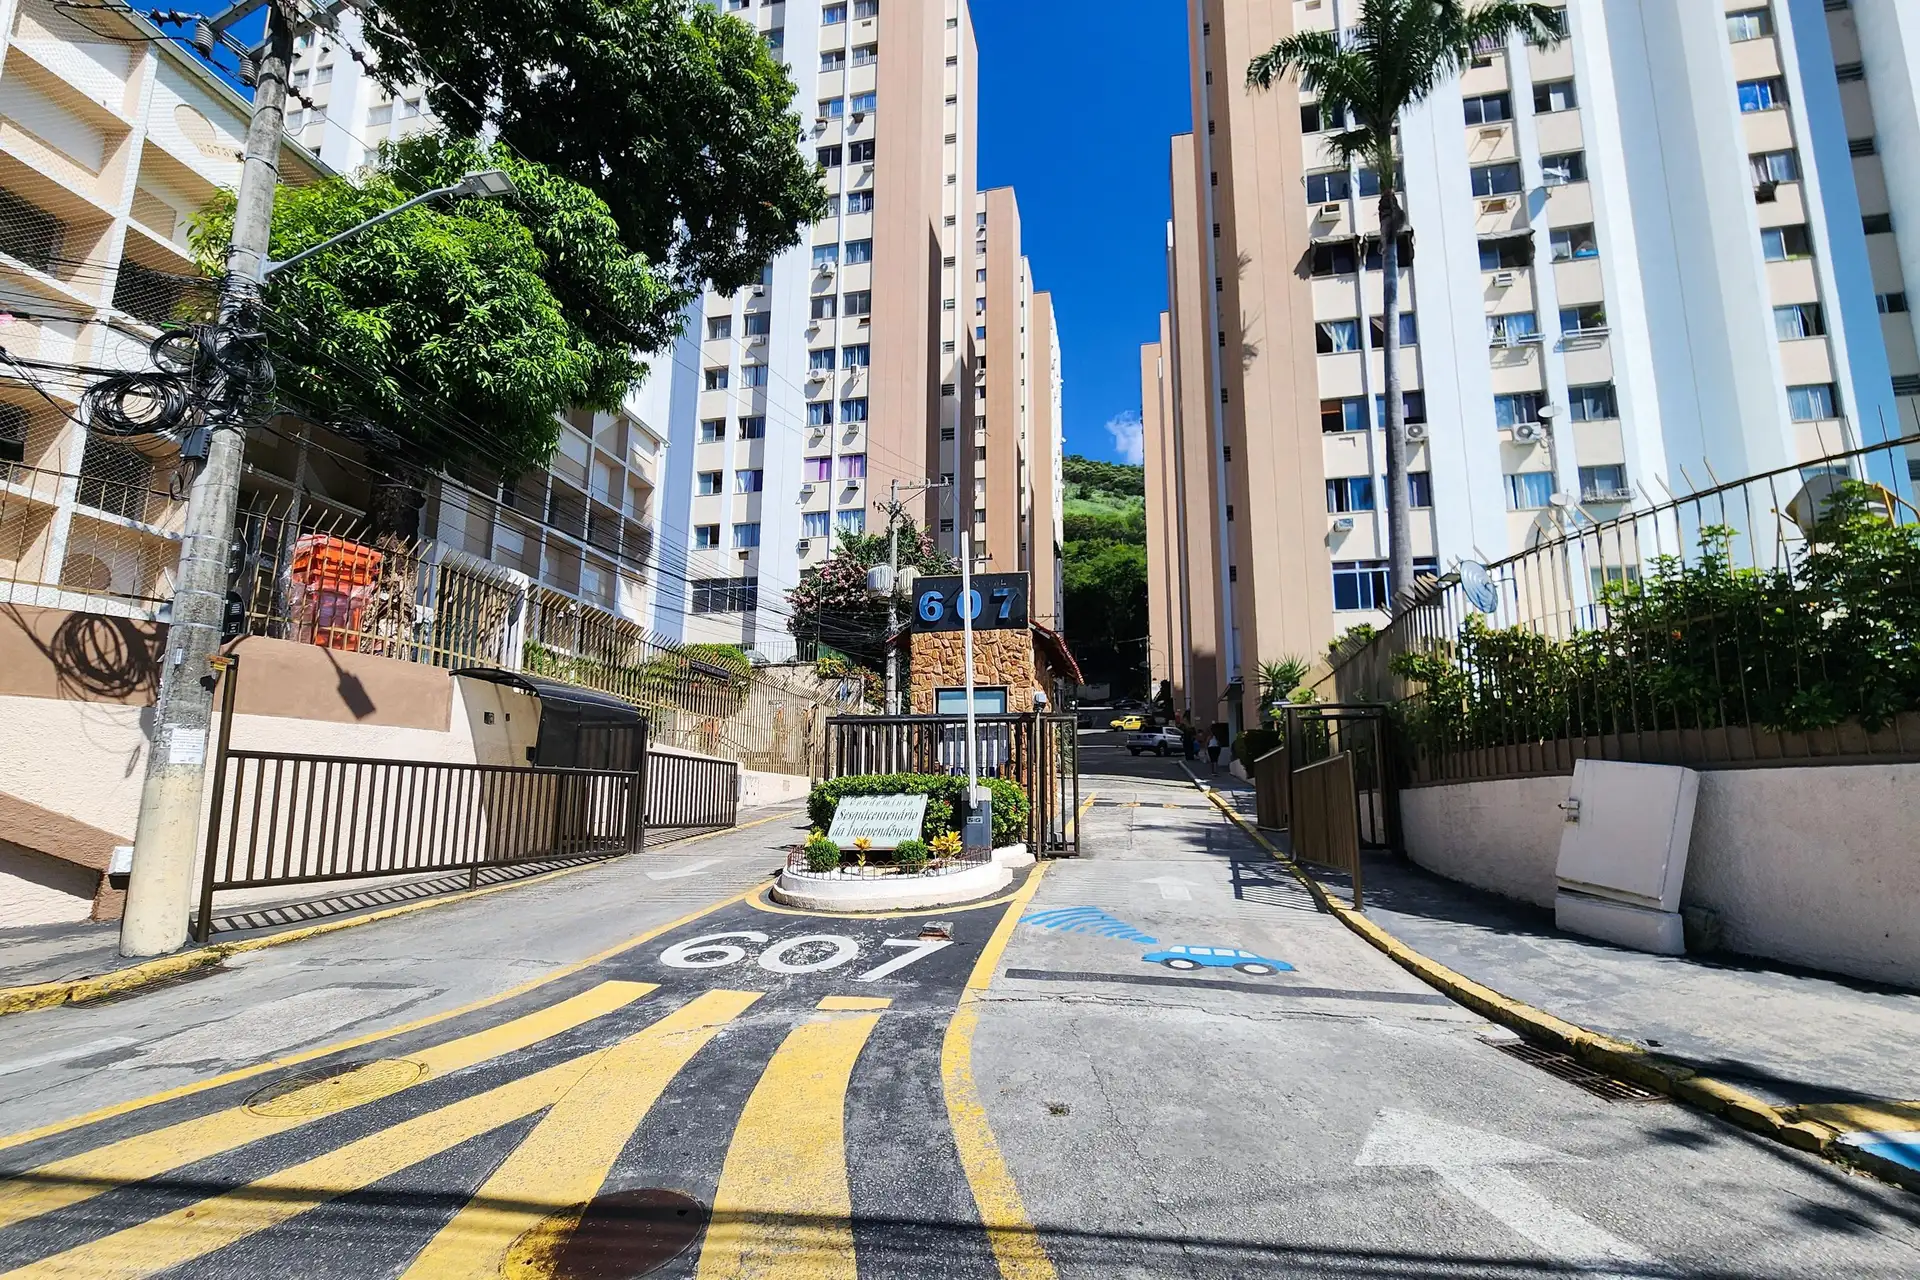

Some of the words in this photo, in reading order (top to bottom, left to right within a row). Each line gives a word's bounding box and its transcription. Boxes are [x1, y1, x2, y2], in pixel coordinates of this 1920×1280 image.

[919, 587, 1019, 621] 607
[832, 823, 845, 836] da
[847, 821, 913, 840] Independência
[660, 931, 954, 982] 607
